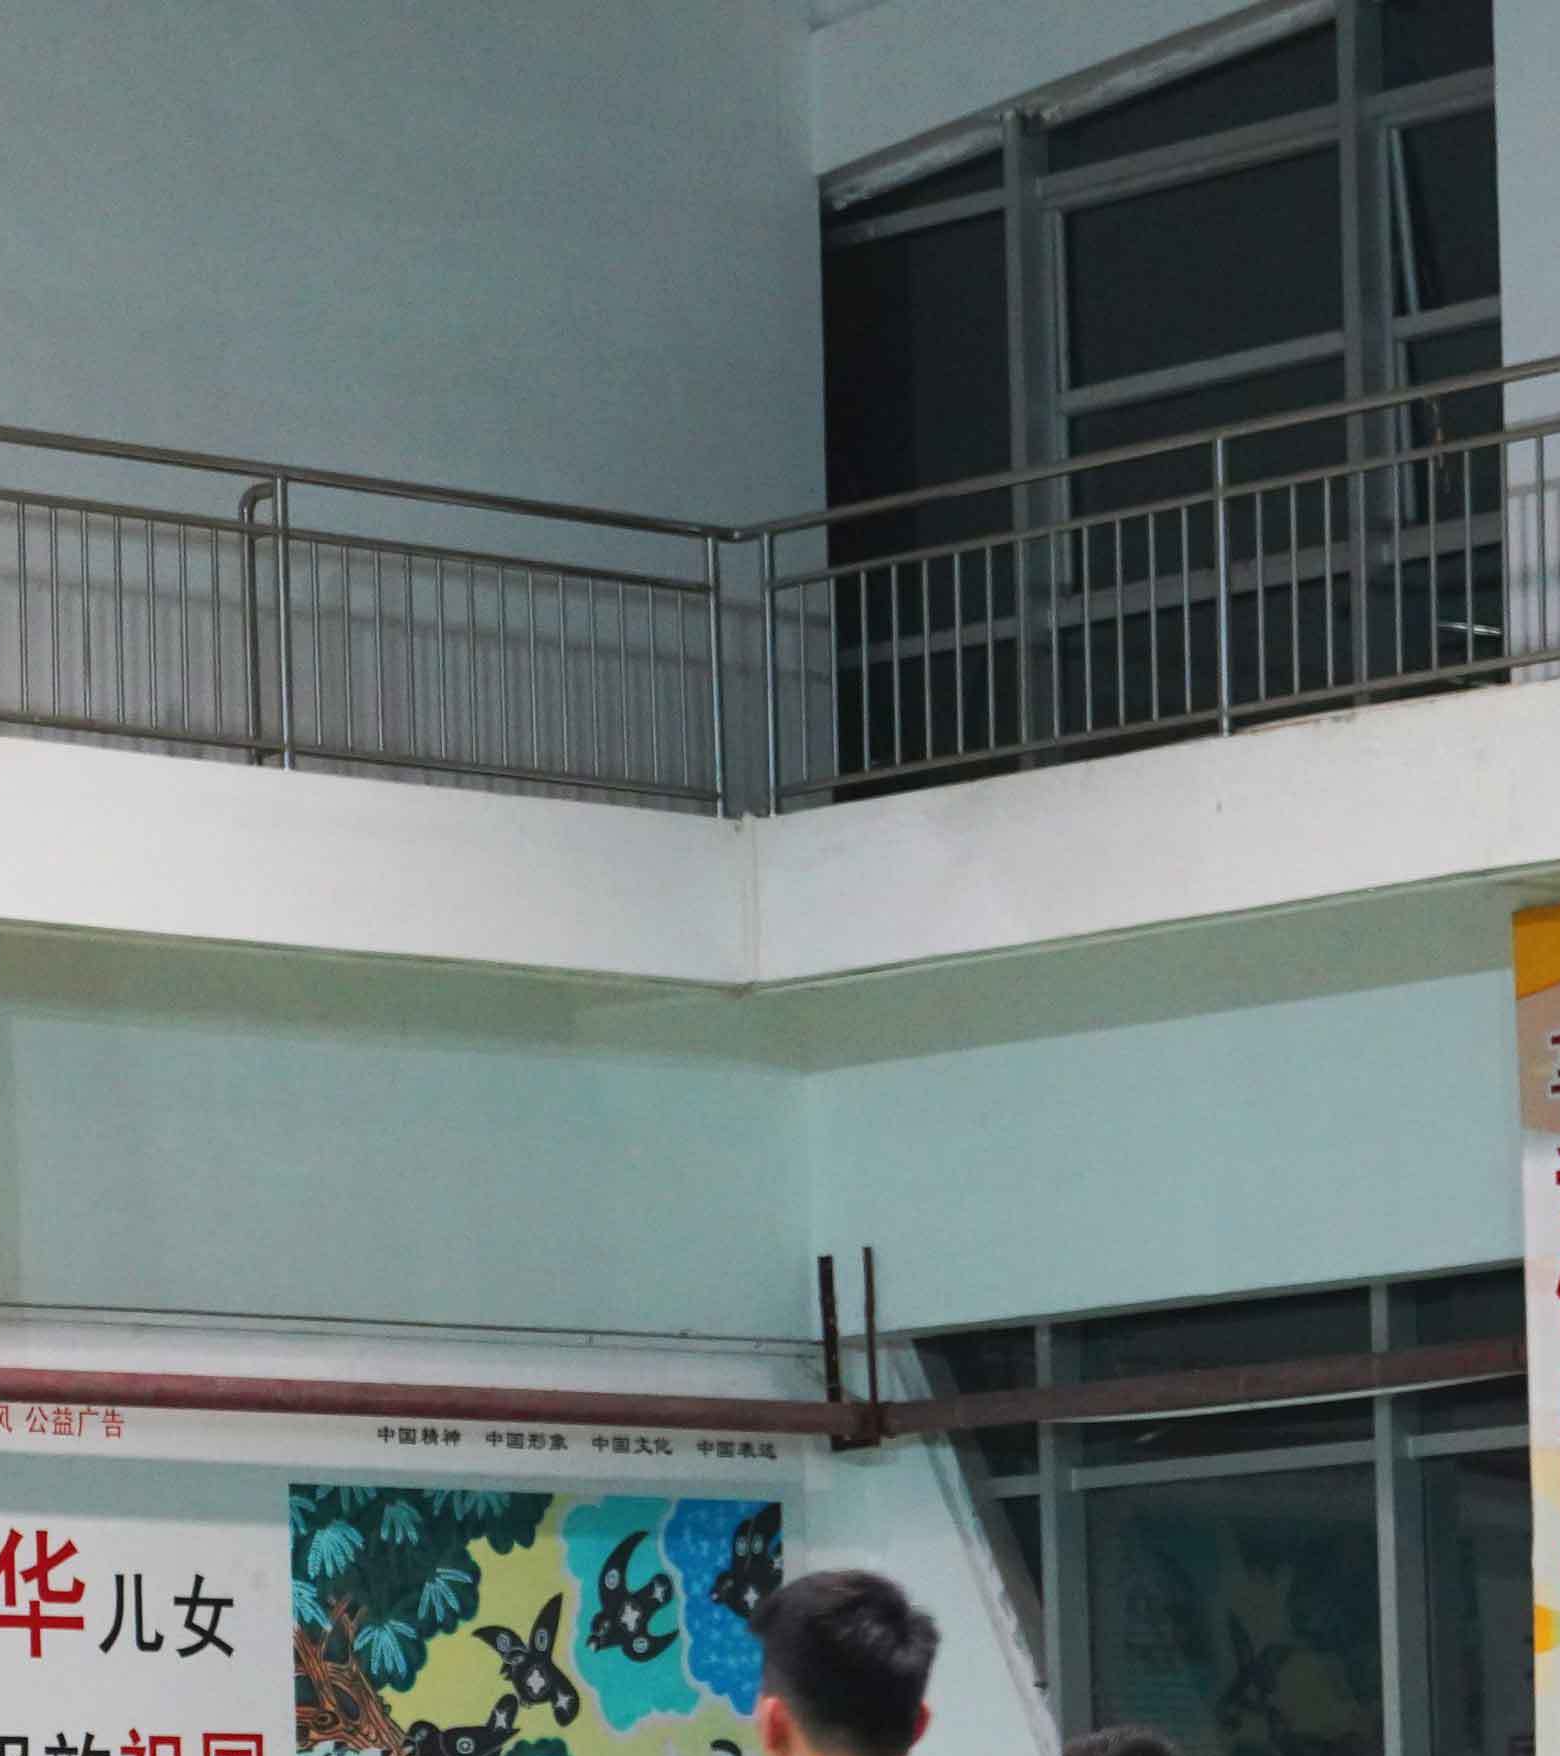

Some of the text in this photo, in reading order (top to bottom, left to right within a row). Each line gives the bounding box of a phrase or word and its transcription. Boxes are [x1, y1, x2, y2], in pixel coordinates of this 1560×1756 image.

[26, 1406, 125, 1438] 公益广告
[377, 1426, 462, 1447] 中国精神
[485, 1431, 569, 1452] 中国形象
[591, 1436, 673, 1457] 中国文化
